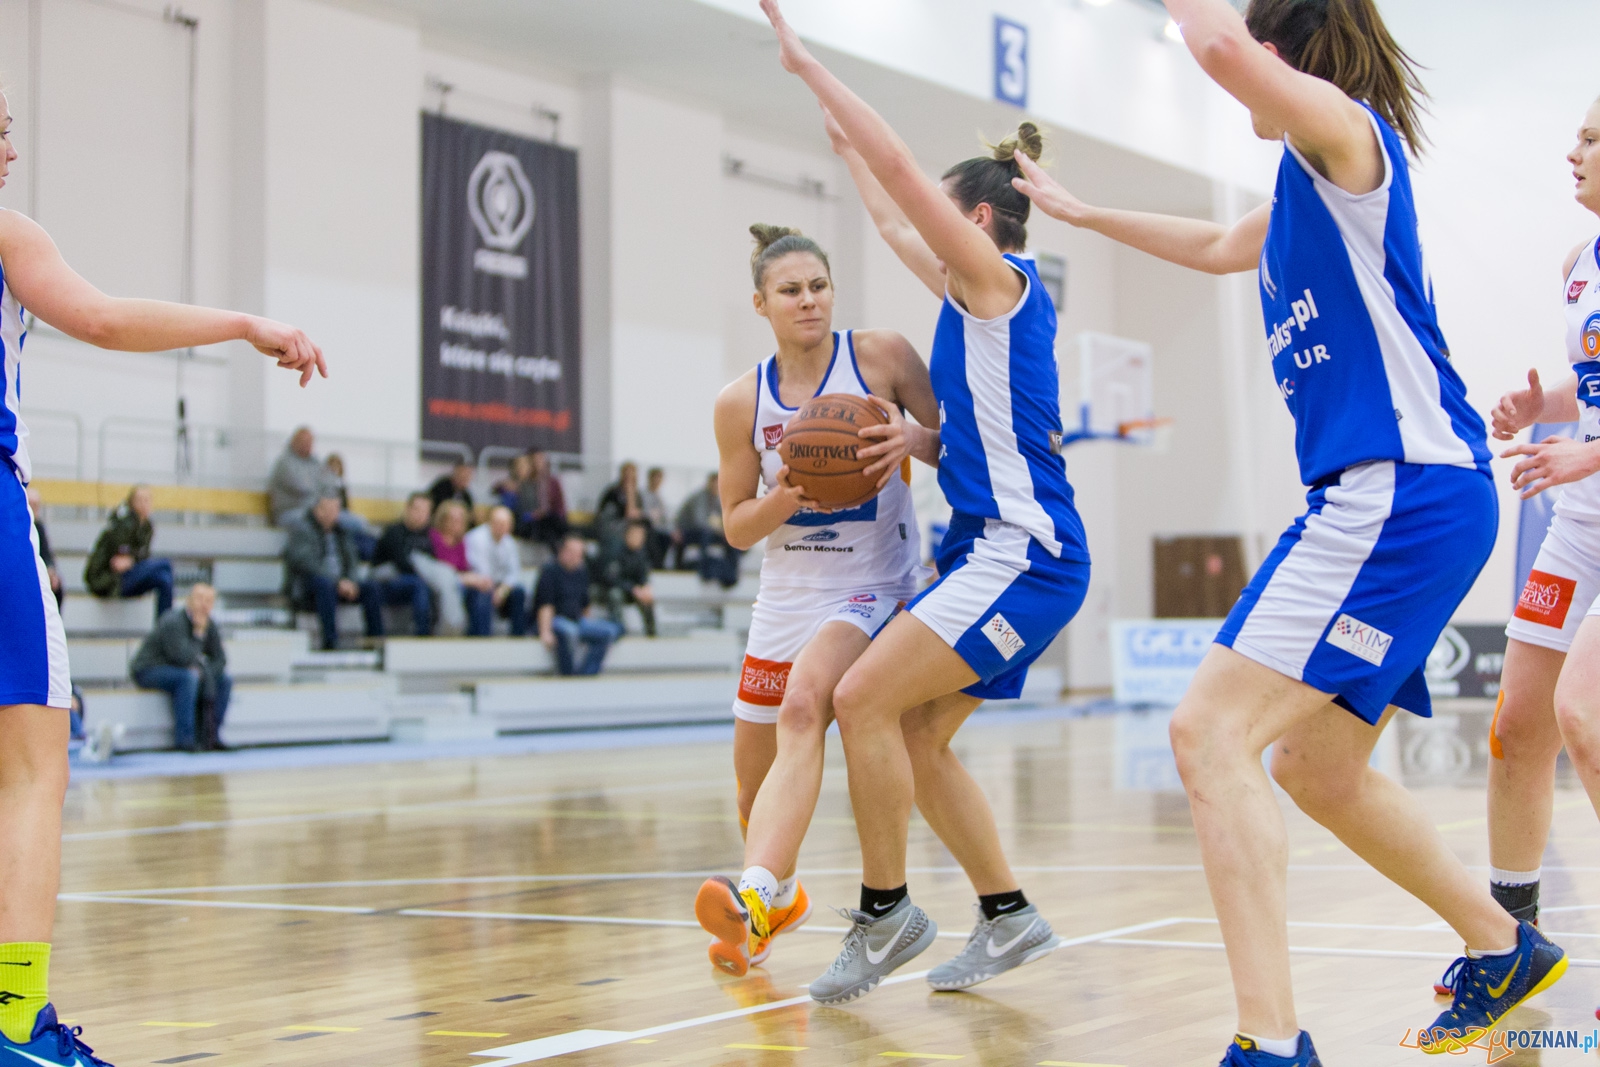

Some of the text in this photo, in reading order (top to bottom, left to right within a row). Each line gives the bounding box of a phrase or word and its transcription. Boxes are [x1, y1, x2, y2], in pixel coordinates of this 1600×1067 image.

[1001, 24, 1024, 97] 3
[788, 442, 859, 462] SPALDING
[814, 545, 853, 553] Motors
[1351, 623, 1391, 654] KIM
